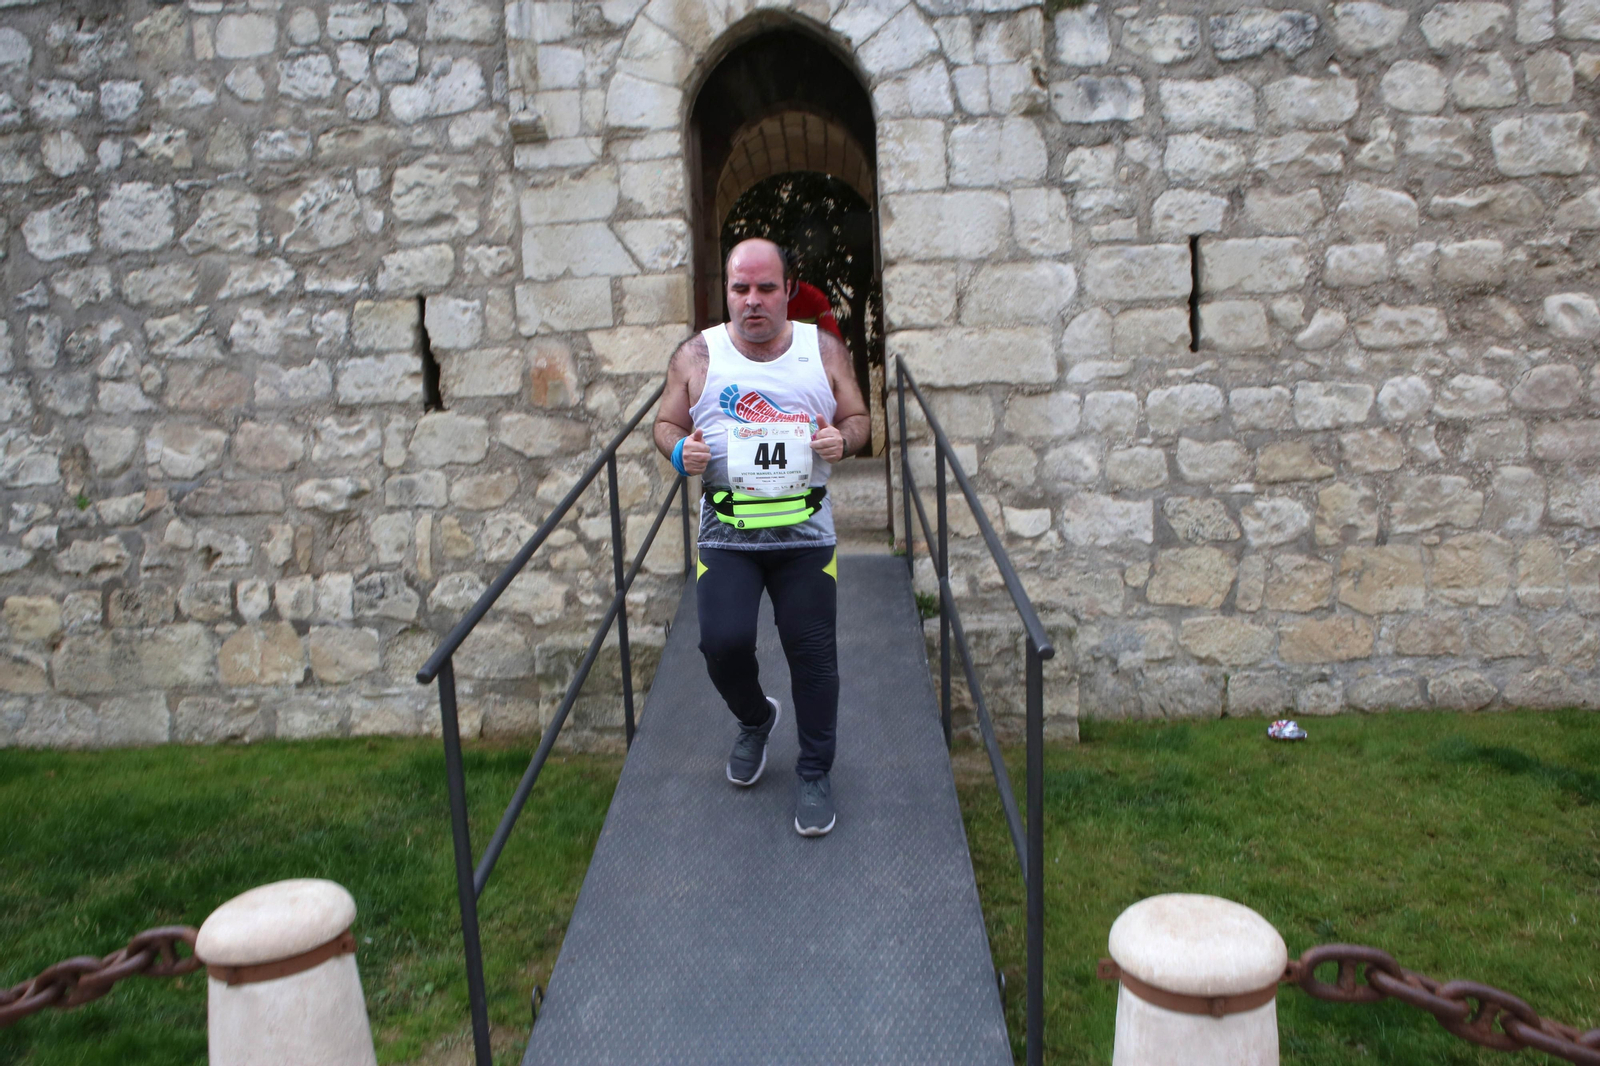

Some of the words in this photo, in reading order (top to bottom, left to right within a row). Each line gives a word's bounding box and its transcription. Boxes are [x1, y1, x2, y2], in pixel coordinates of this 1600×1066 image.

[736, 403, 769, 423] CIUDAD
[740, 391, 761, 407] IX
[753, 400, 777, 417] MEDIA
[754, 442, 787, 470] 44
